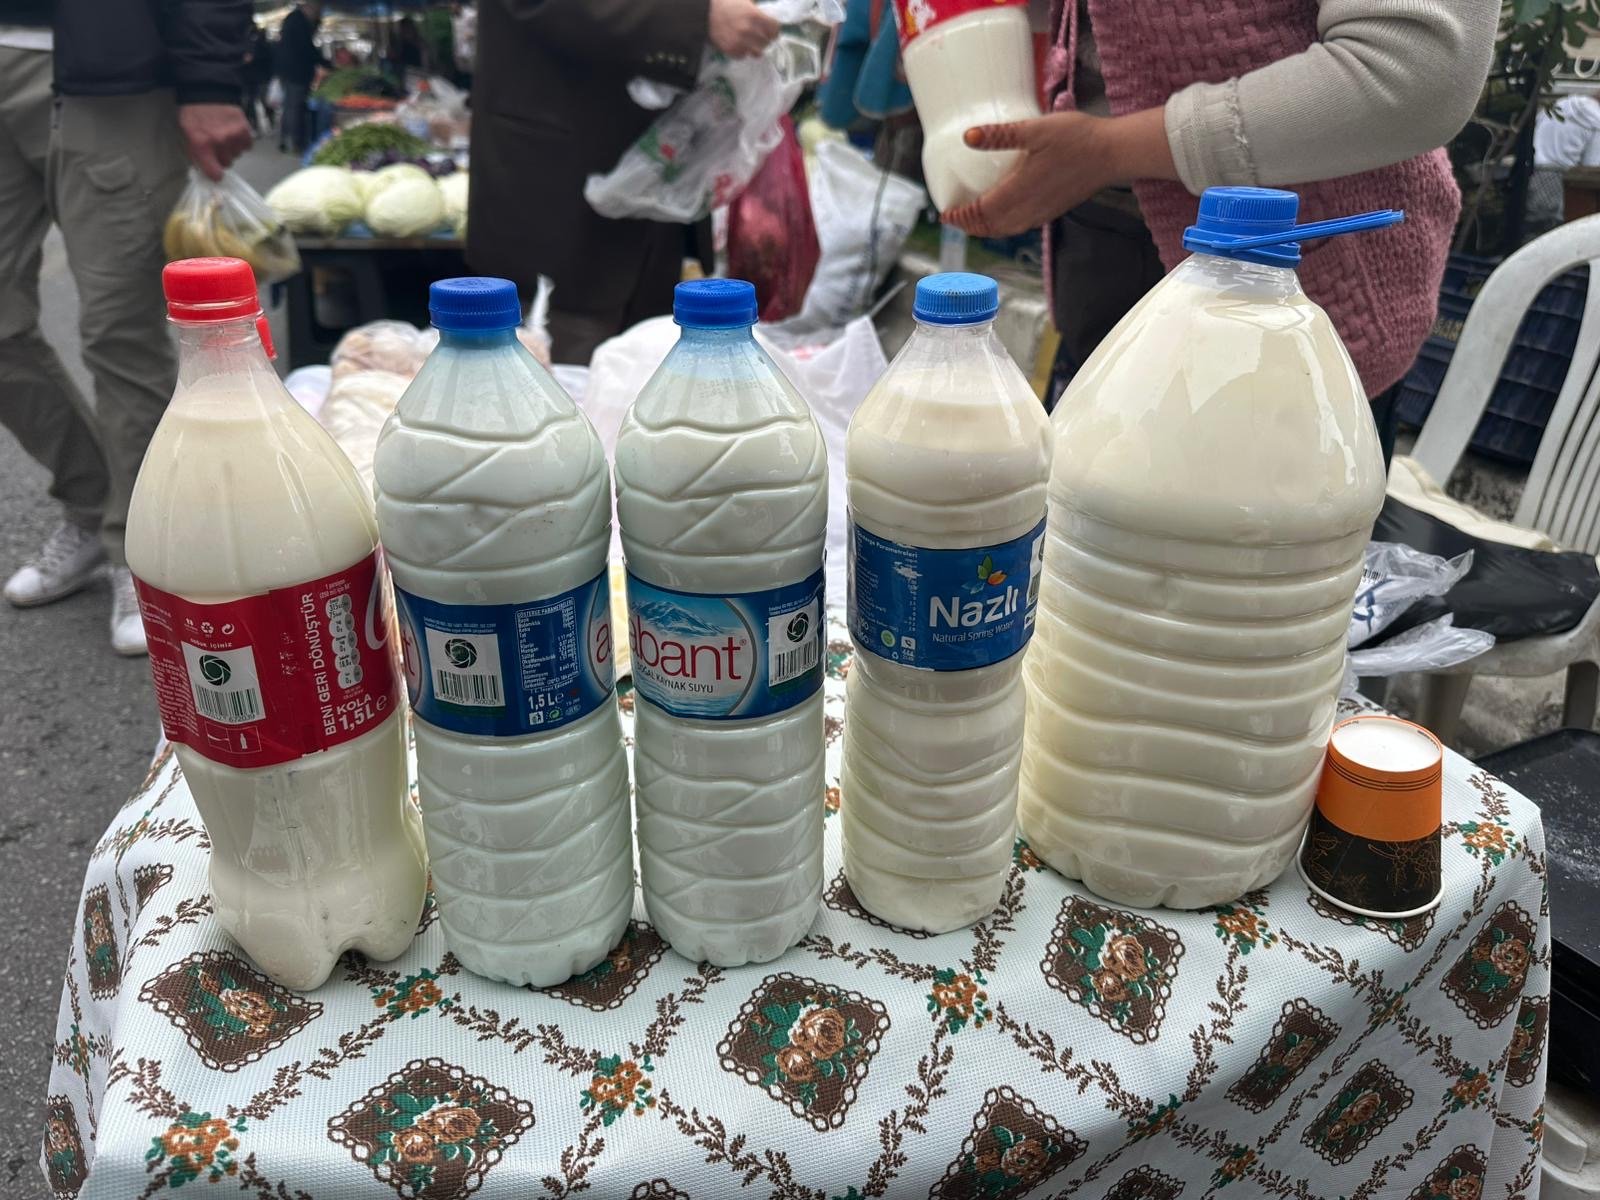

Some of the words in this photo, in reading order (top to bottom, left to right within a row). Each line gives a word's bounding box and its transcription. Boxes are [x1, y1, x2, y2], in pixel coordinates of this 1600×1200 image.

[929, 585, 1018, 628] Nazlı
[300, 592, 325, 670] DÖNÜŞTÜR
[932, 632, 966, 644] Natural
[968, 628, 994, 642] Spring
[995, 619, 1015, 635] Water
[314, 671, 331, 702] GERİ
[656, 674, 686, 692] KAYNAK
[688, 682, 714, 694] SUYU
[337, 693, 372, 715] KOLA
[339, 702, 375, 730] 1,5L
[528, 693, 546, 711] 1,5
[321, 706, 337, 736] BENİ
